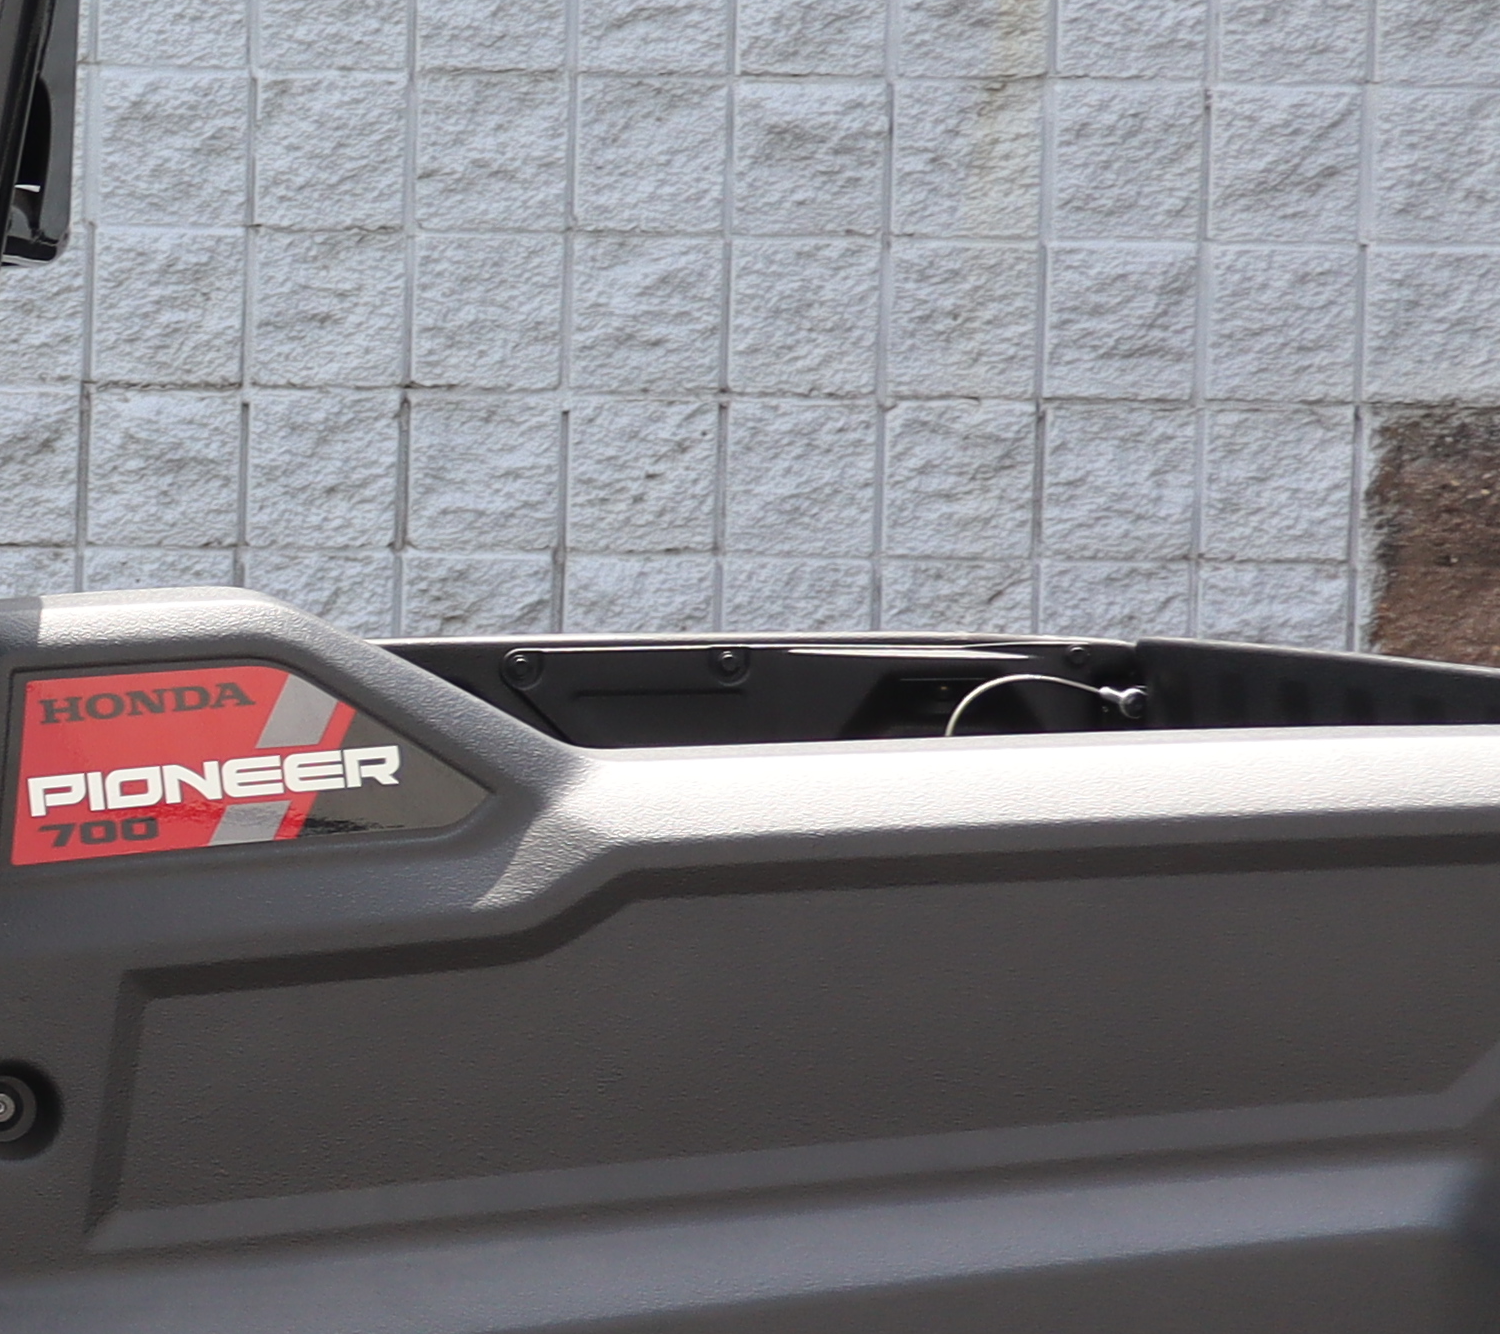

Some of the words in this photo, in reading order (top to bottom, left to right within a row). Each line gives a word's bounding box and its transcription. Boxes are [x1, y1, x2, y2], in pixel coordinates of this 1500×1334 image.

[39, 681, 256, 725] HONDA
[27, 745, 401, 818] PIONEER
[38, 817, 160, 849] 700
